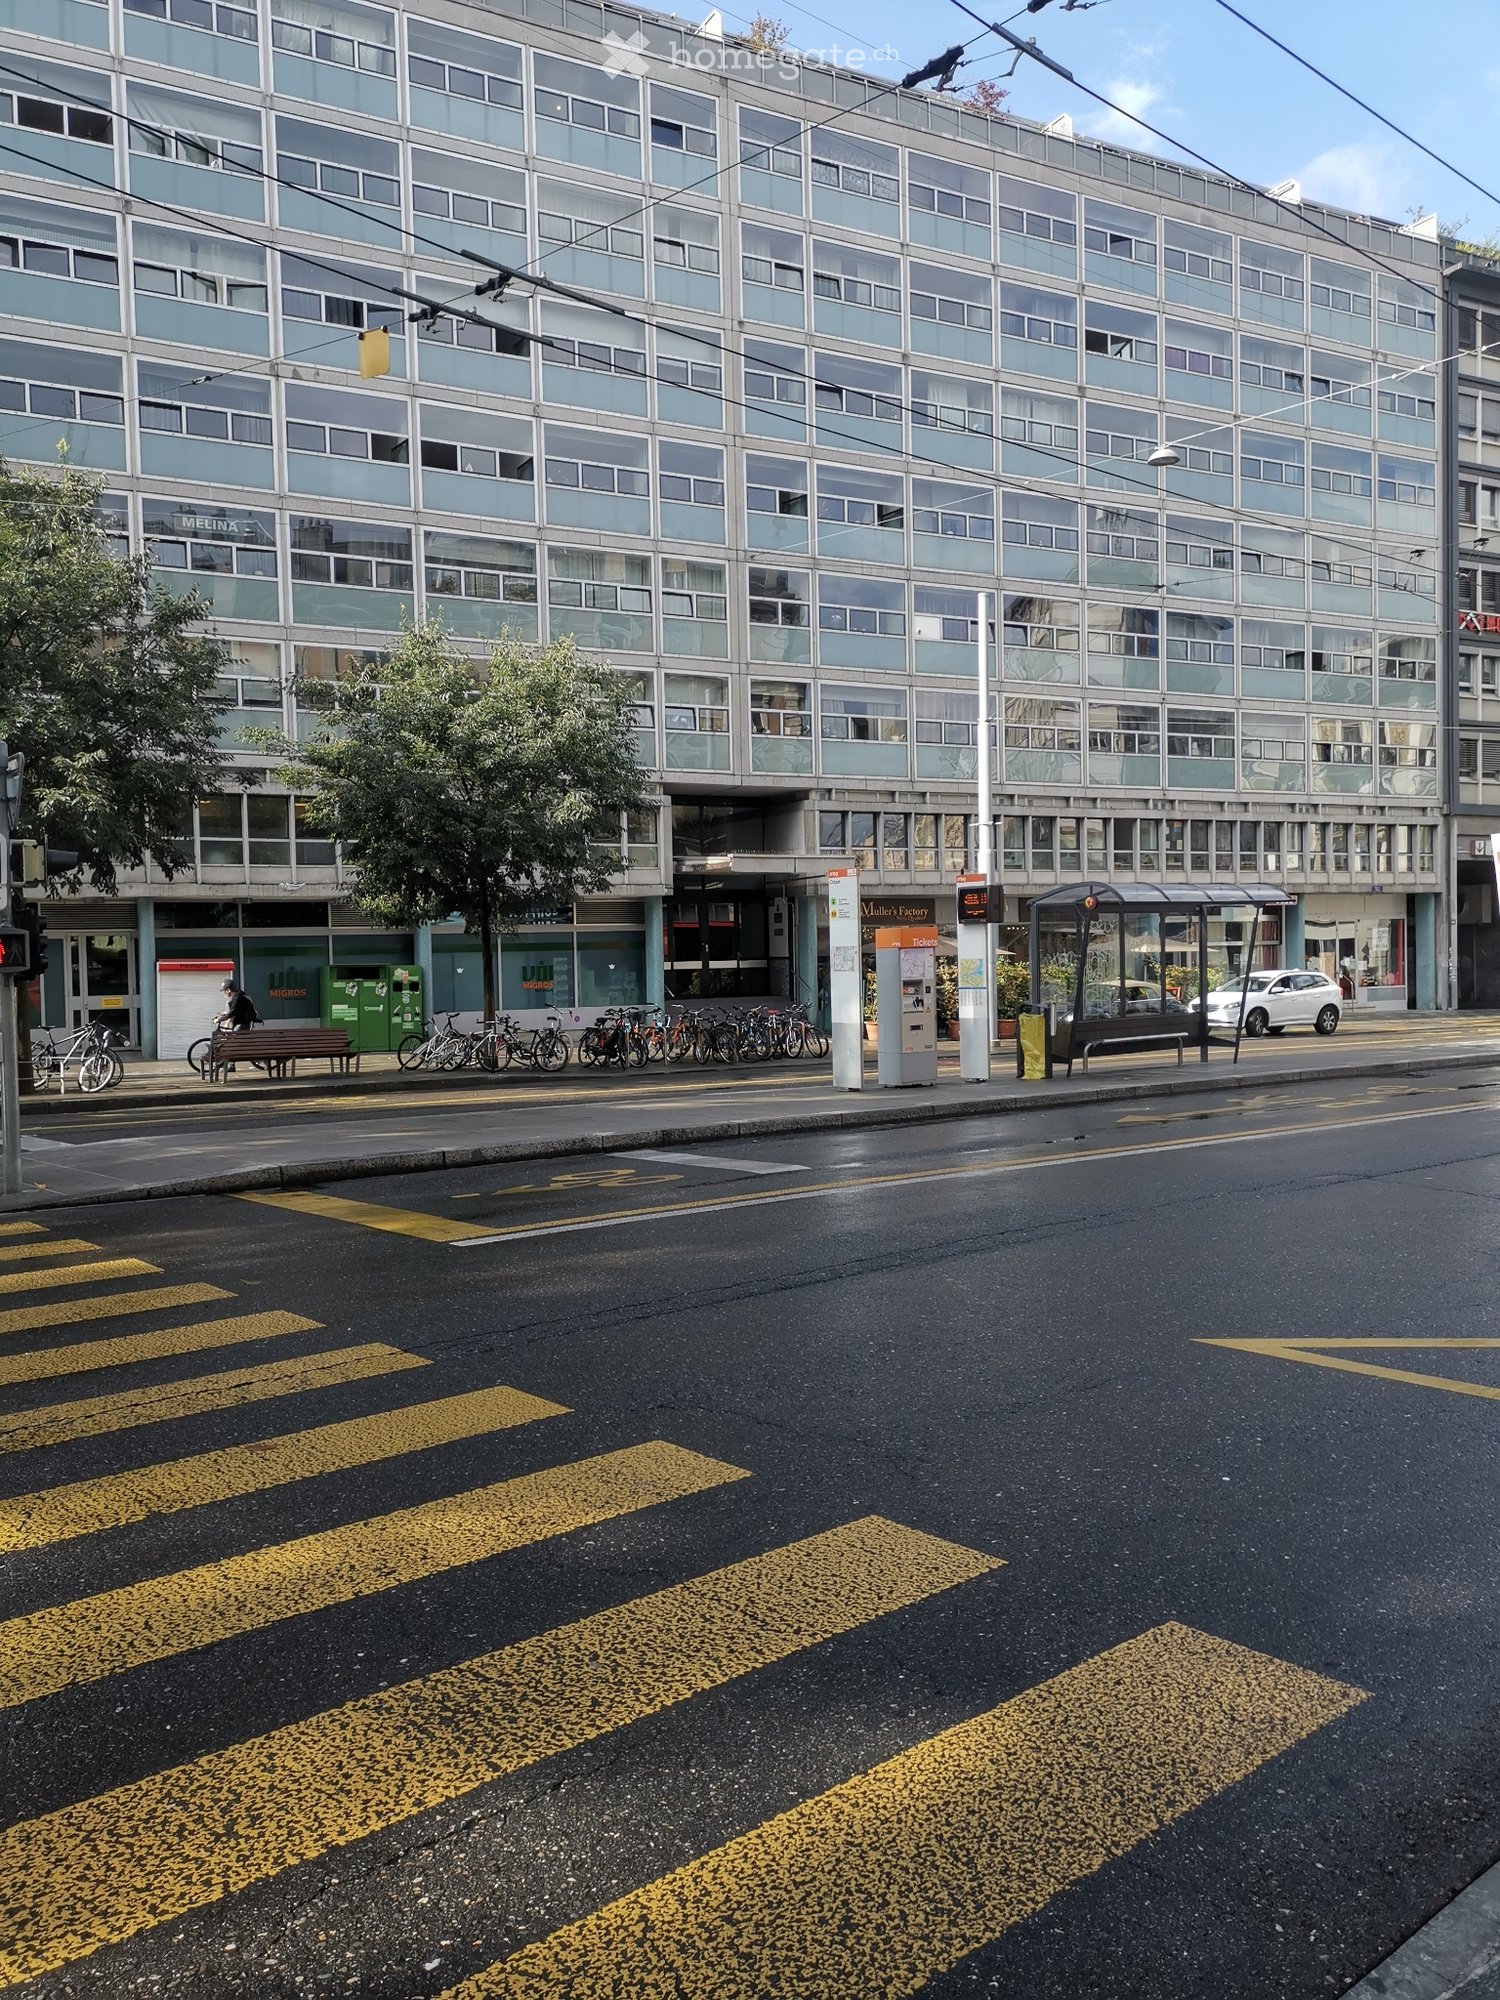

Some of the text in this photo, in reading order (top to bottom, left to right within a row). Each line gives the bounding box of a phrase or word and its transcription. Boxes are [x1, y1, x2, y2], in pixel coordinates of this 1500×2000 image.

[182, 516, 238, 533] MELINA
[860, 901, 897, 917] Muller's
[899, 905, 929, 920] Factory
[912, 937, 939, 947] Tickets
[522, 981, 555, 989] MIGROS
[269, 989, 306, 998] MIGROS
